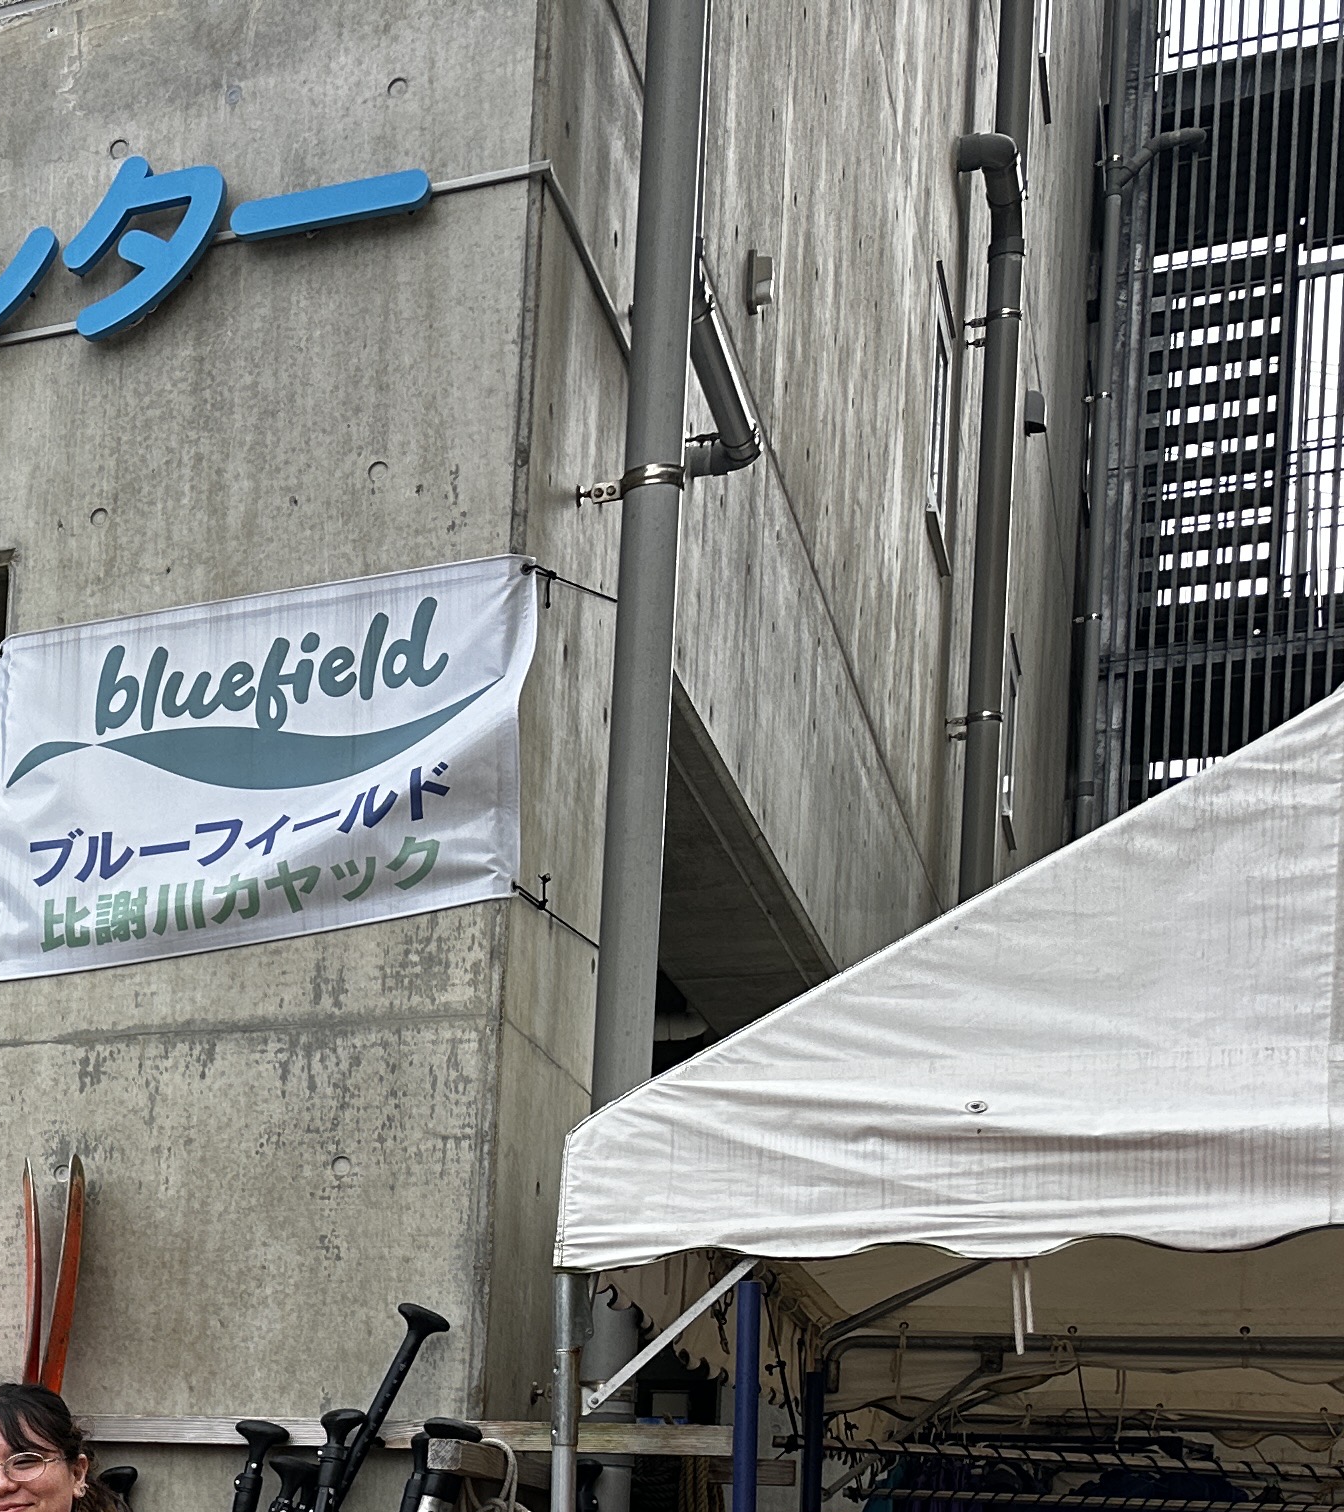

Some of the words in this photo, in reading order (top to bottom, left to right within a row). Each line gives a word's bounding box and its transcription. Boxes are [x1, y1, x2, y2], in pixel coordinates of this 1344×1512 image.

[95, 596, 449, 736] bluefield
[29, 761, 451, 888] ブルーフィールド
[40, 836, 442, 953] 比謝川カヤック
